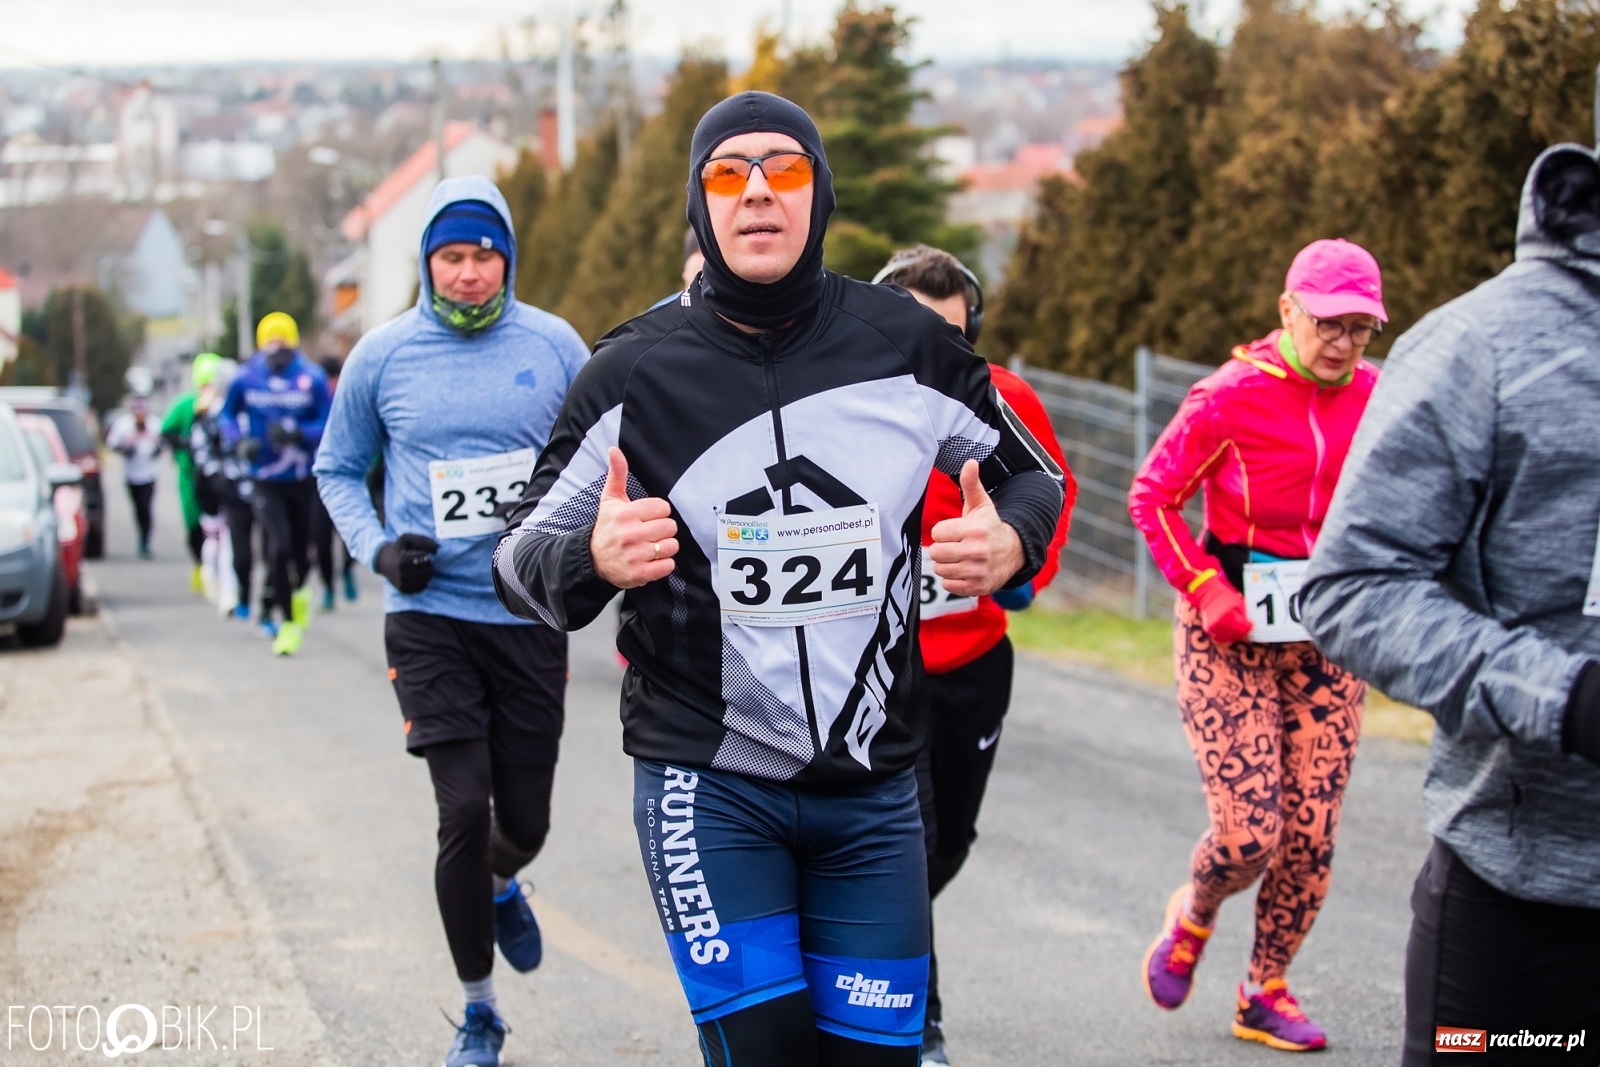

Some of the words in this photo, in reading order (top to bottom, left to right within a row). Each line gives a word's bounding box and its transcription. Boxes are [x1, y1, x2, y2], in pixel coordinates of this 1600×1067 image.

[726, 519, 769, 528] PersonalBest
[777, 518, 874, 538] www.personalbest.pl
[730, 548, 874, 606] 324
[660, 765, 730, 965] RUNNERS
[658, 887, 675, 931] TEAM
